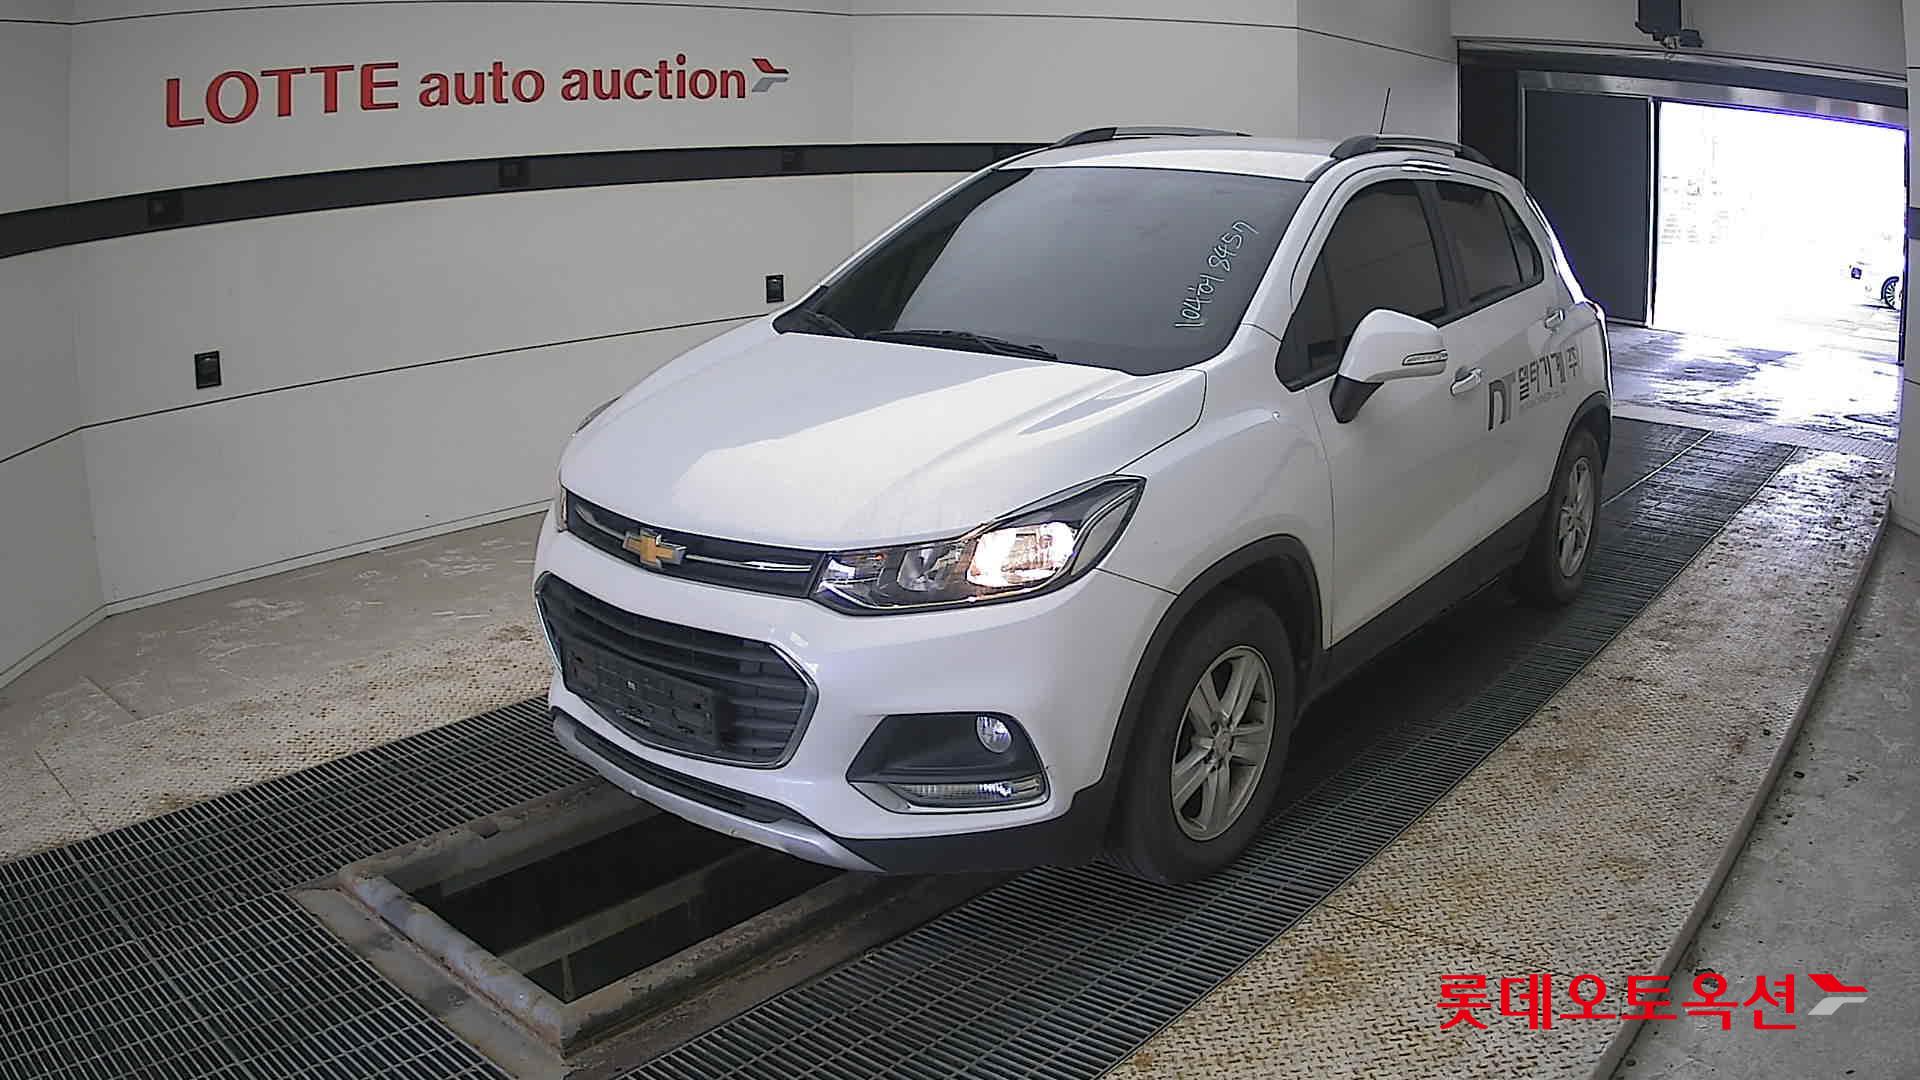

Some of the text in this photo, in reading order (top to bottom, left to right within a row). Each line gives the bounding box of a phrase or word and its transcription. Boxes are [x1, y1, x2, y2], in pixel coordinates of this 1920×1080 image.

[164, 53, 748, 128] LOTTE auto auction
